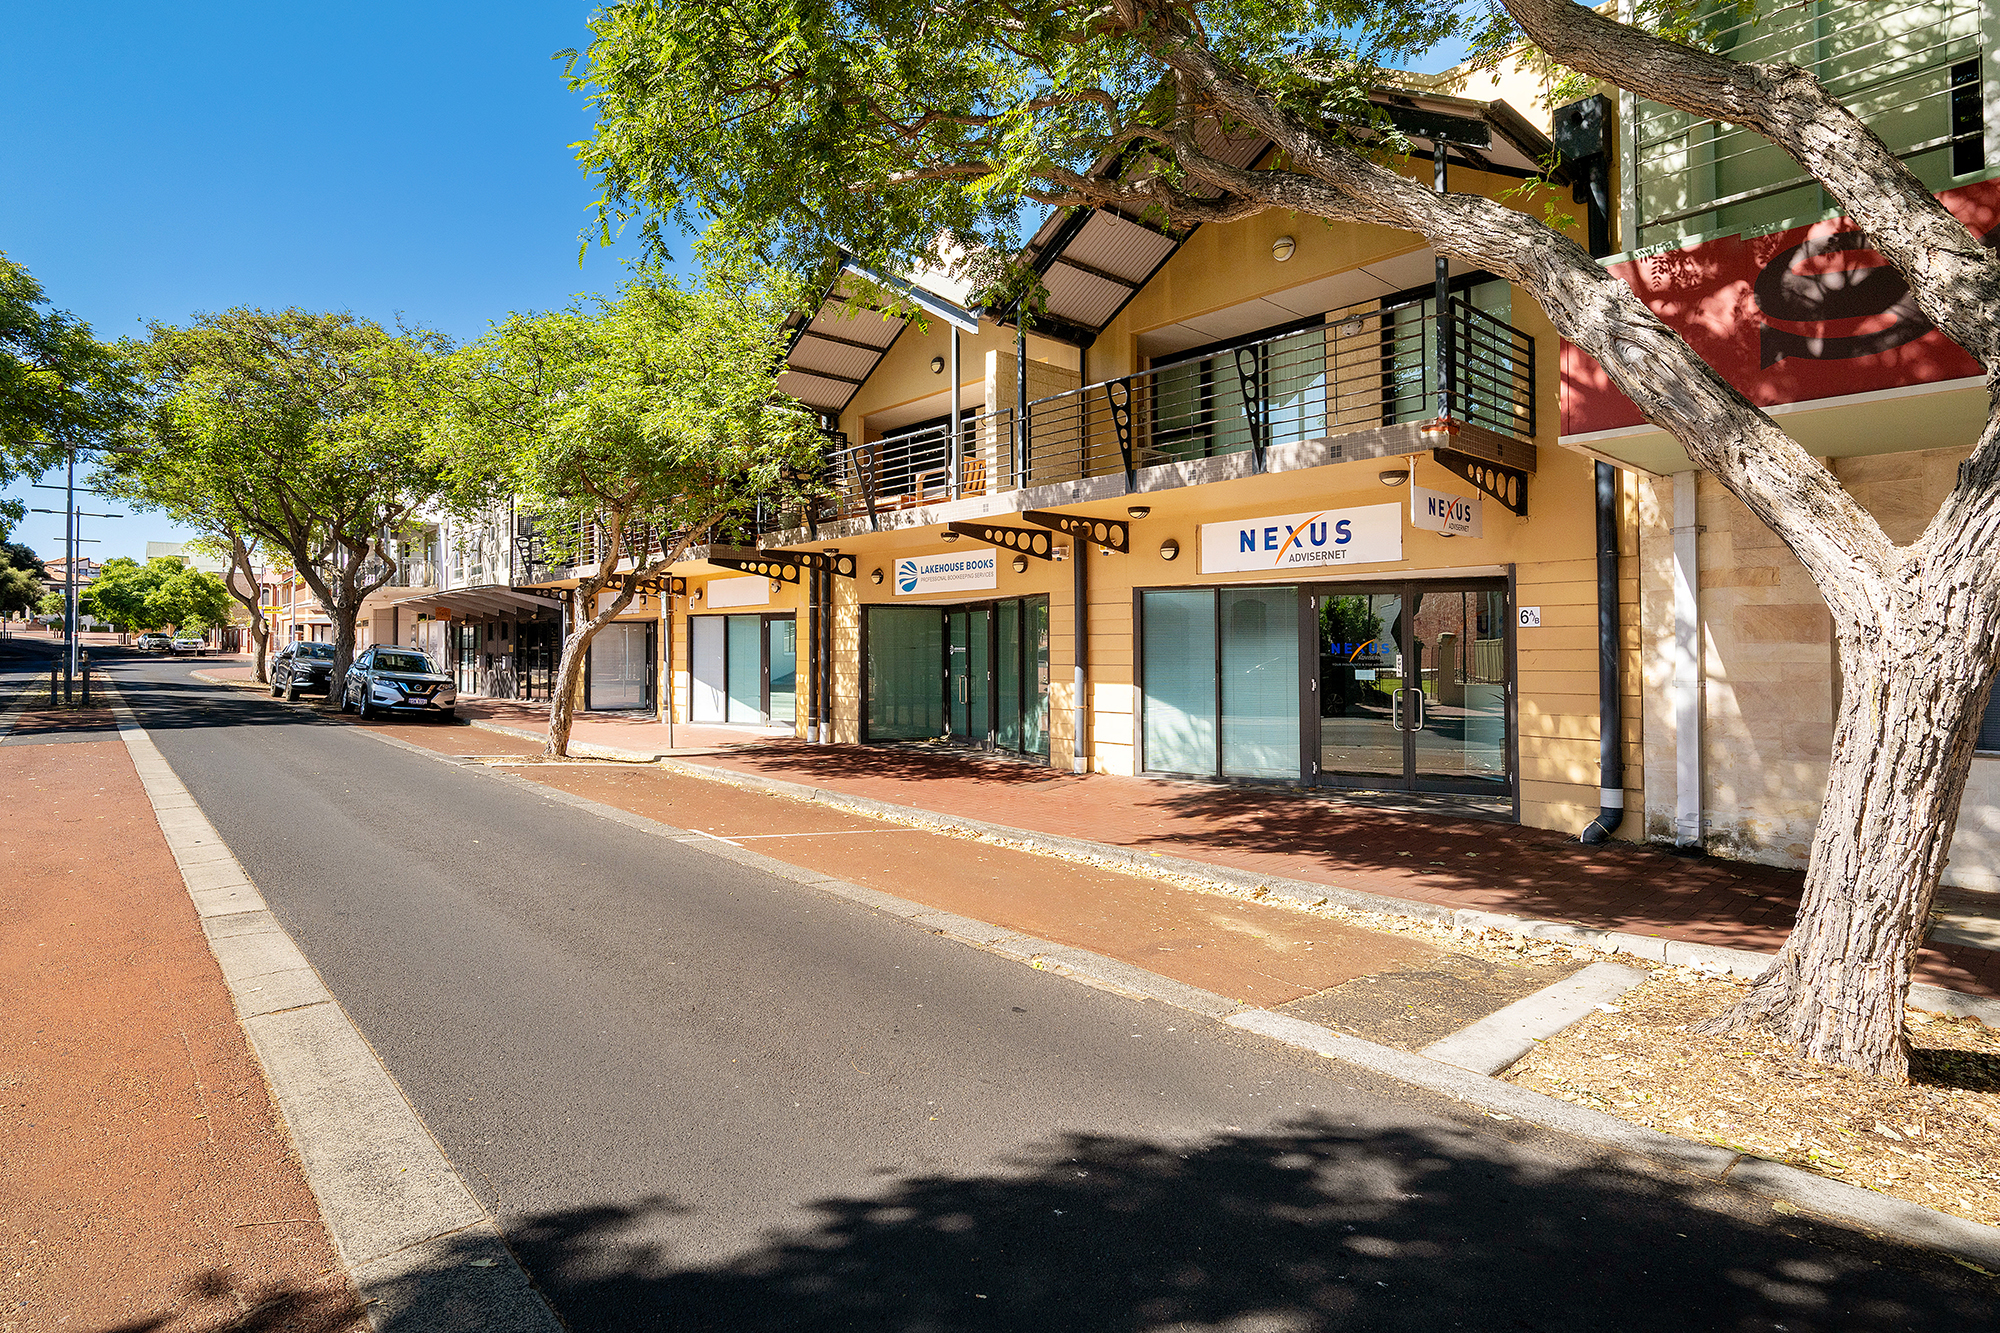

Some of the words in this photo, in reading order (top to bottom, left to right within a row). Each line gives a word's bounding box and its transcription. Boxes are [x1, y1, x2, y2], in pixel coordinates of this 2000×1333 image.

[1429, 497, 1471, 523] NEXUS
[1240, 517, 1352, 556] NEXUS
[1288, 549, 1347, 563] ADVISERNET
[920, 561, 964, 575] LAKEHOUSE
[966, 558, 994, 571] BOOKS
[1331, 641, 1390, 656] NEXUS
